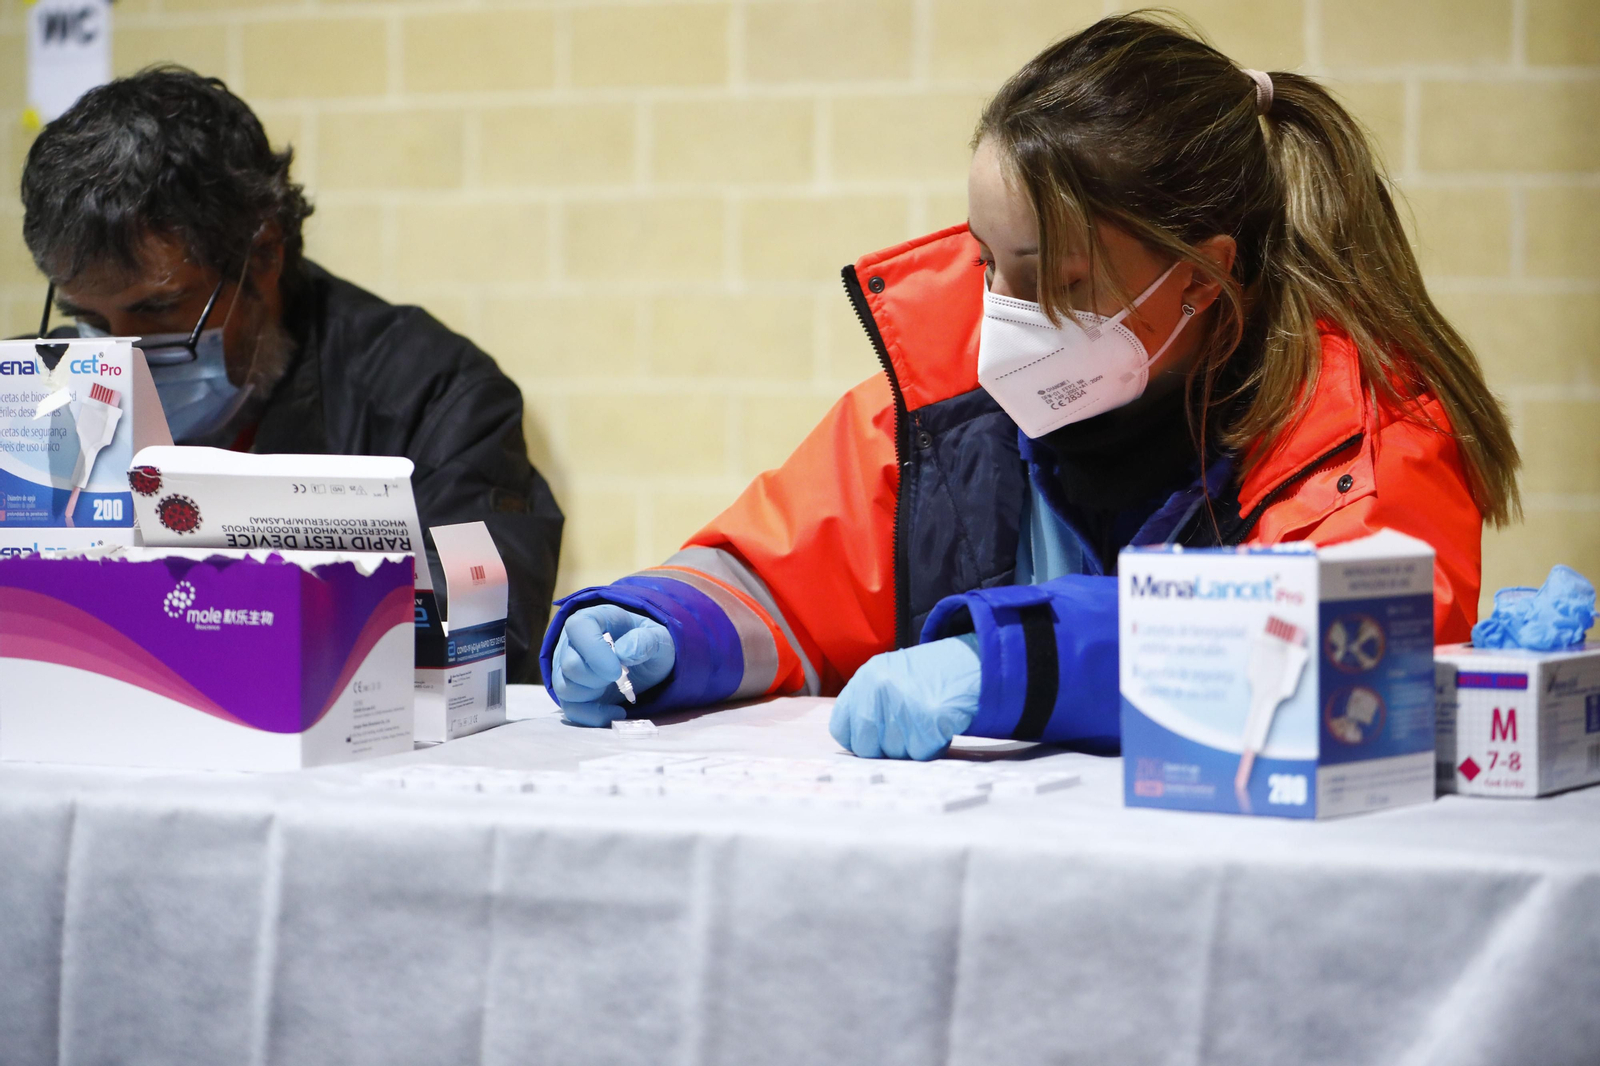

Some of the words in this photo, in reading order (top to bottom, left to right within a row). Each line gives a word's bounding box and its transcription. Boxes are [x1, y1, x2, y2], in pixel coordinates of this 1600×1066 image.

[43, 8, 95, 46] WC
[100, 364, 122, 376] Pro
[0, 394, 19, 402] cetas
[20, 391, 30, 402] de
[1065, 389, 1087, 403] 2834
[0, 428, 19, 437] cetas
[21, 426, 30, 437] de
[31, 428, 67, 440] segurança
[16, 441, 26, 452] de
[27, 443, 39, 452] uso
[41, 440, 60, 452] único
[93, 499, 123, 521] 200
[250, 517, 367, 527] BLOOD/SERUM/PLASMA)
[370, 519, 407, 527] WHOLE
[221, 525, 300, 534] BLOOD/VENOUS
[303, 526, 339, 535] WHOLE
[340, 527, 409, 536] (FINGERSTICK
[226, 534, 298, 548] DEVICE
[304, 536, 347, 549] TEST
[351, 536, 412, 551] RAPID
[186, 606, 222, 624] mole
[1491, 707, 1518, 742] M
[1486, 751, 1522, 772] 7-8
